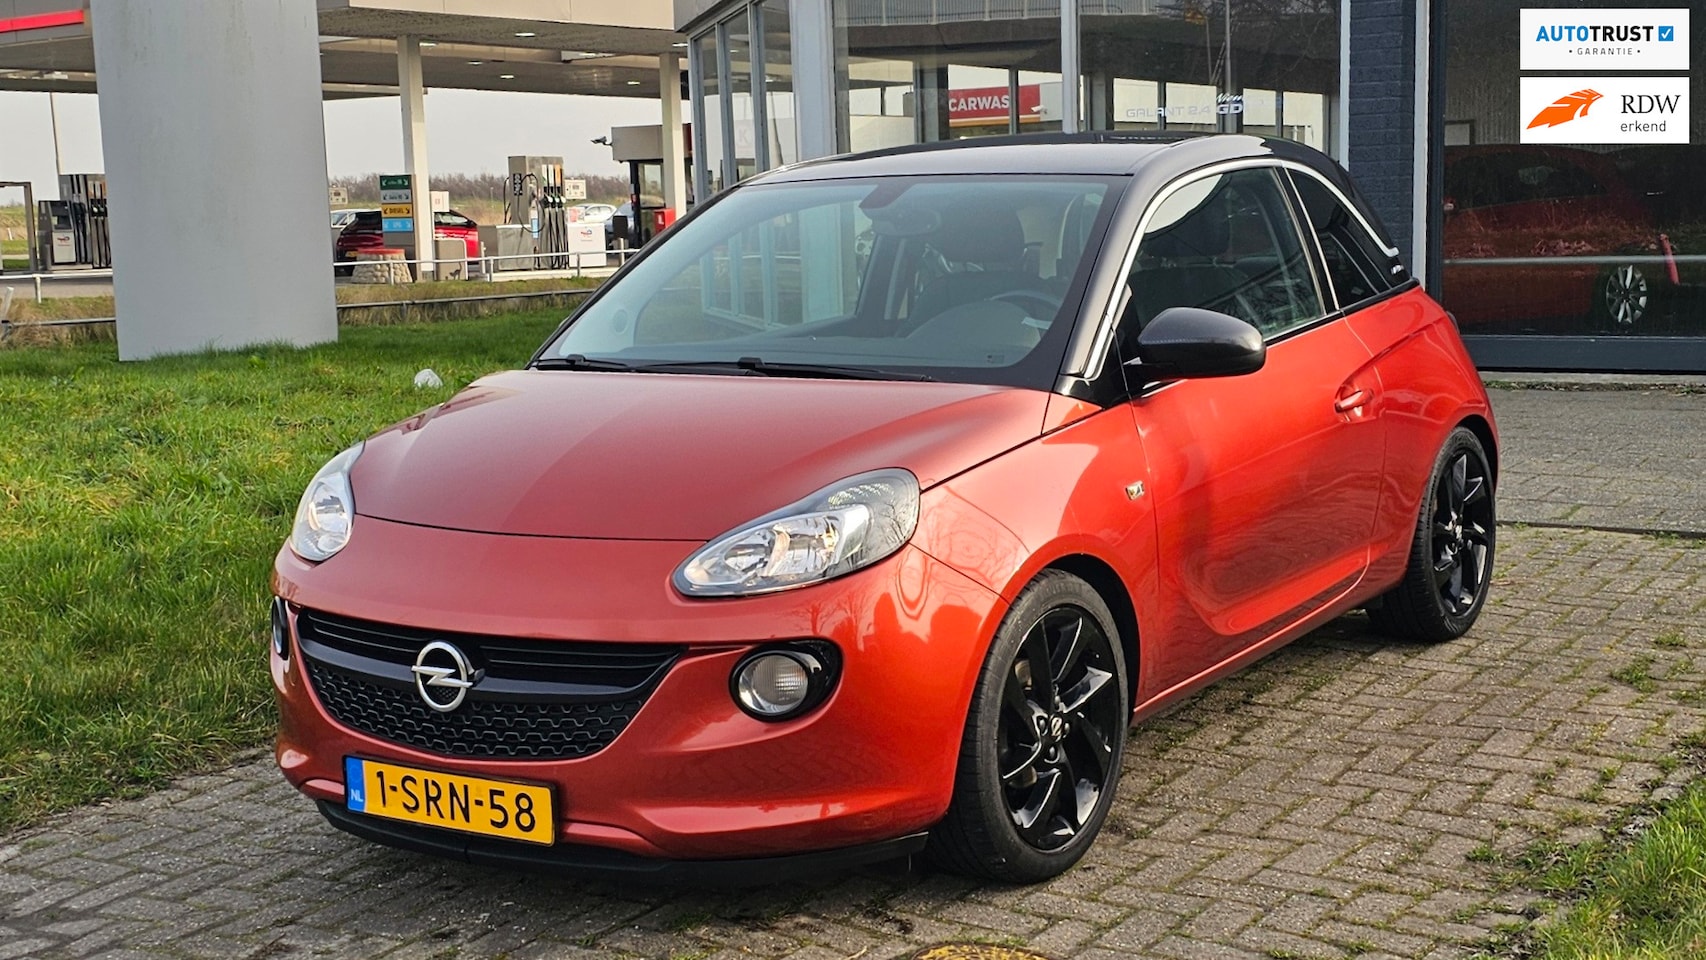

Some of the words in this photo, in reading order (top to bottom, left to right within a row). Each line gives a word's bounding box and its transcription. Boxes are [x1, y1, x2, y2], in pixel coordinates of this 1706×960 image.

[949, 94, 1010, 112] CARWAS
[1126, 106, 1184, 118] GALANT
[1188, 105, 1211, 116] 2.4
[350, 788, 364, 802] NL
[376, 770, 536, 833] 1-SRN-58
